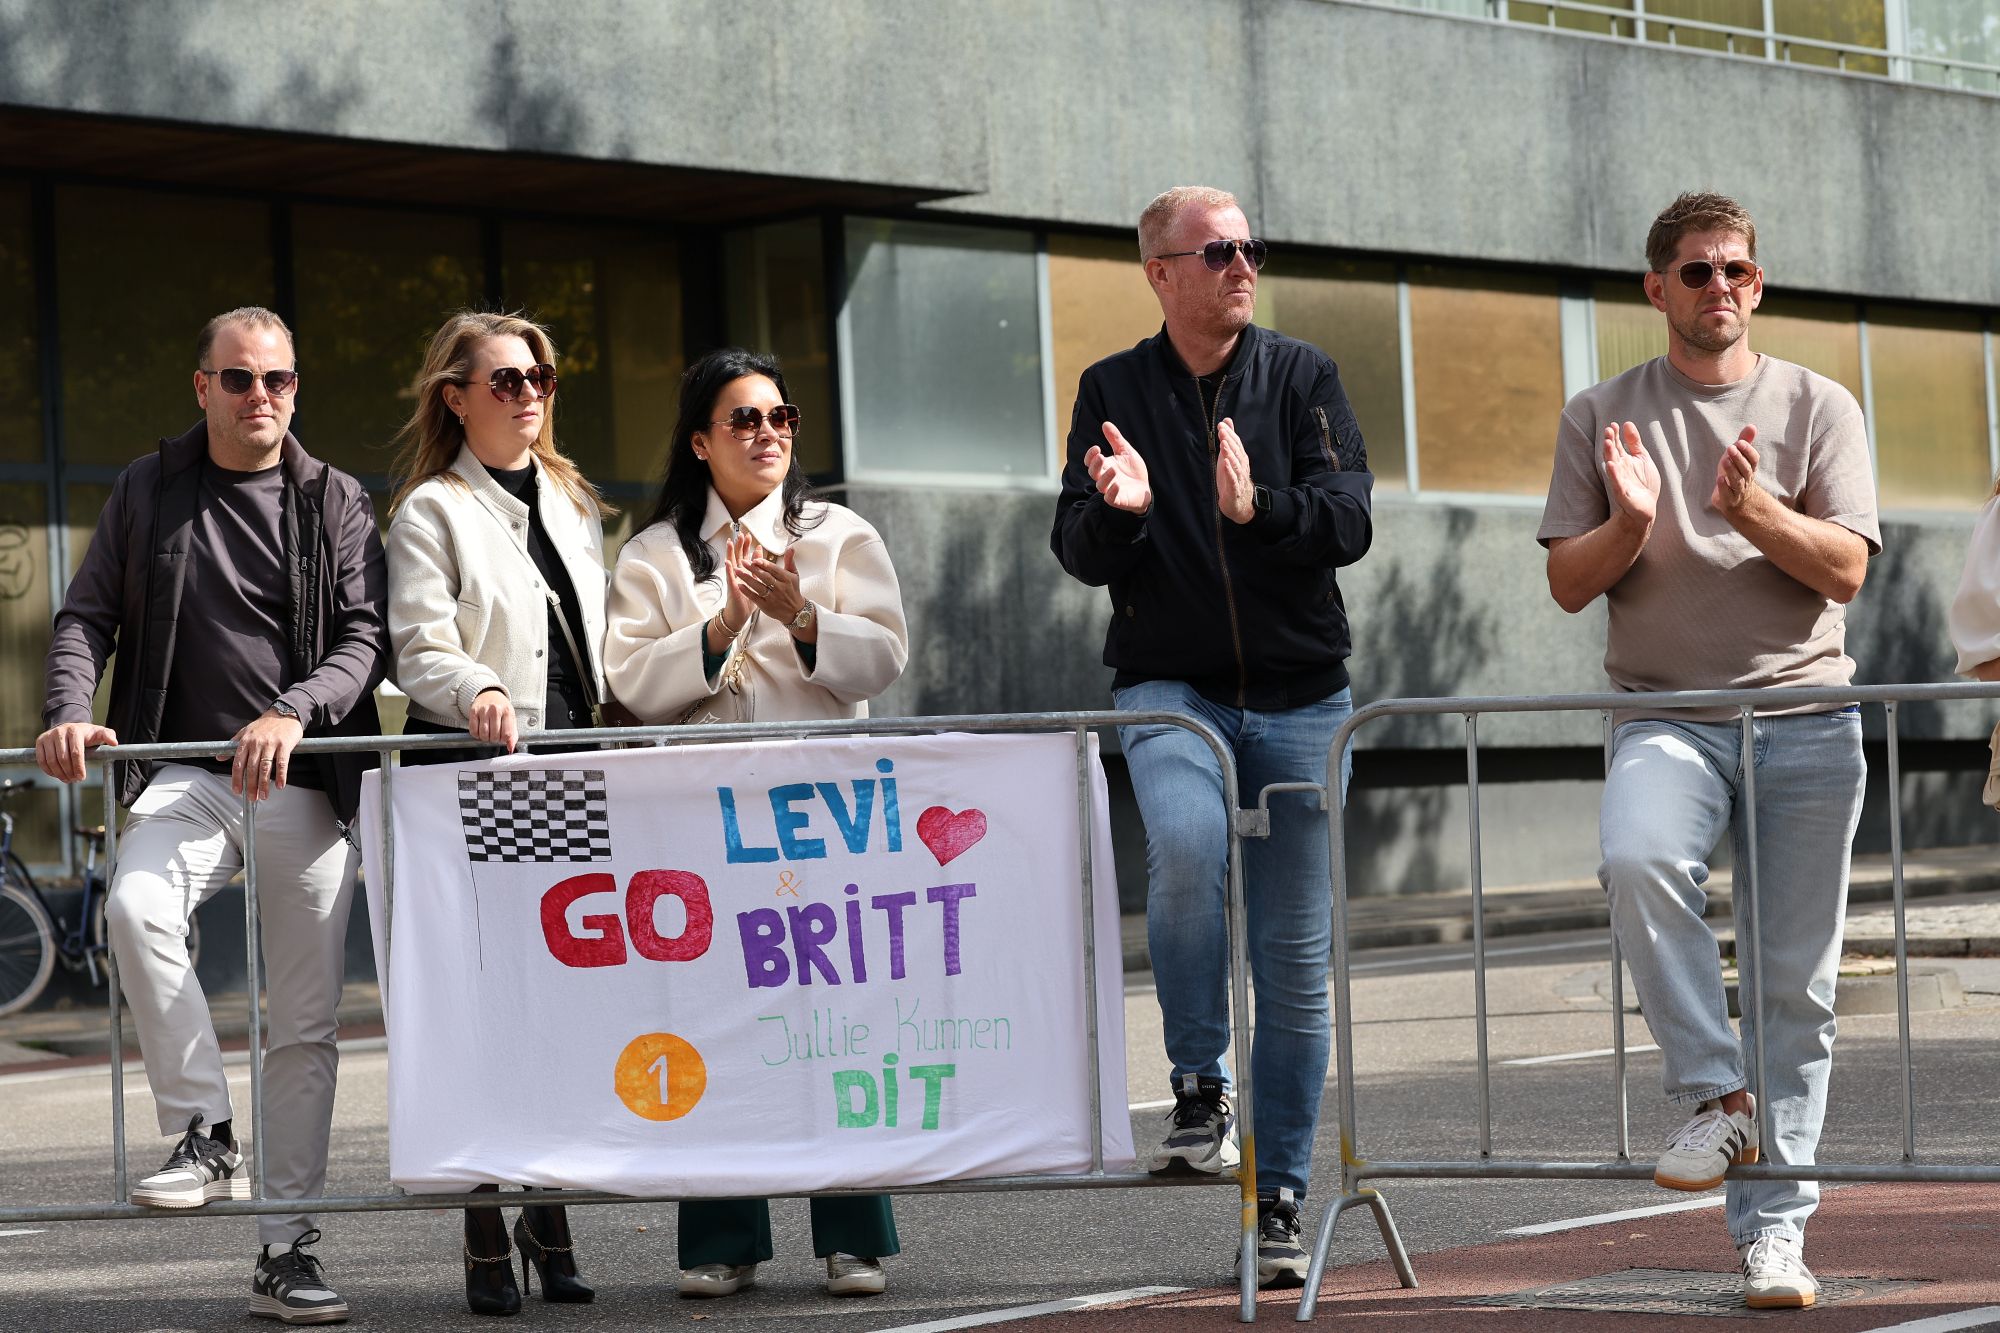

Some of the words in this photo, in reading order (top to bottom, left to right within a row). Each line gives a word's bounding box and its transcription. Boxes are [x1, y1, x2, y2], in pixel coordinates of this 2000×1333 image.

[775, 869, 802, 897] &
[540, 869, 713, 968] GO
[757, 1007, 870, 1066] Jullie
[895, 996, 1012, 1053] Kunnen
[647, 1054, 668, 1105] 1
